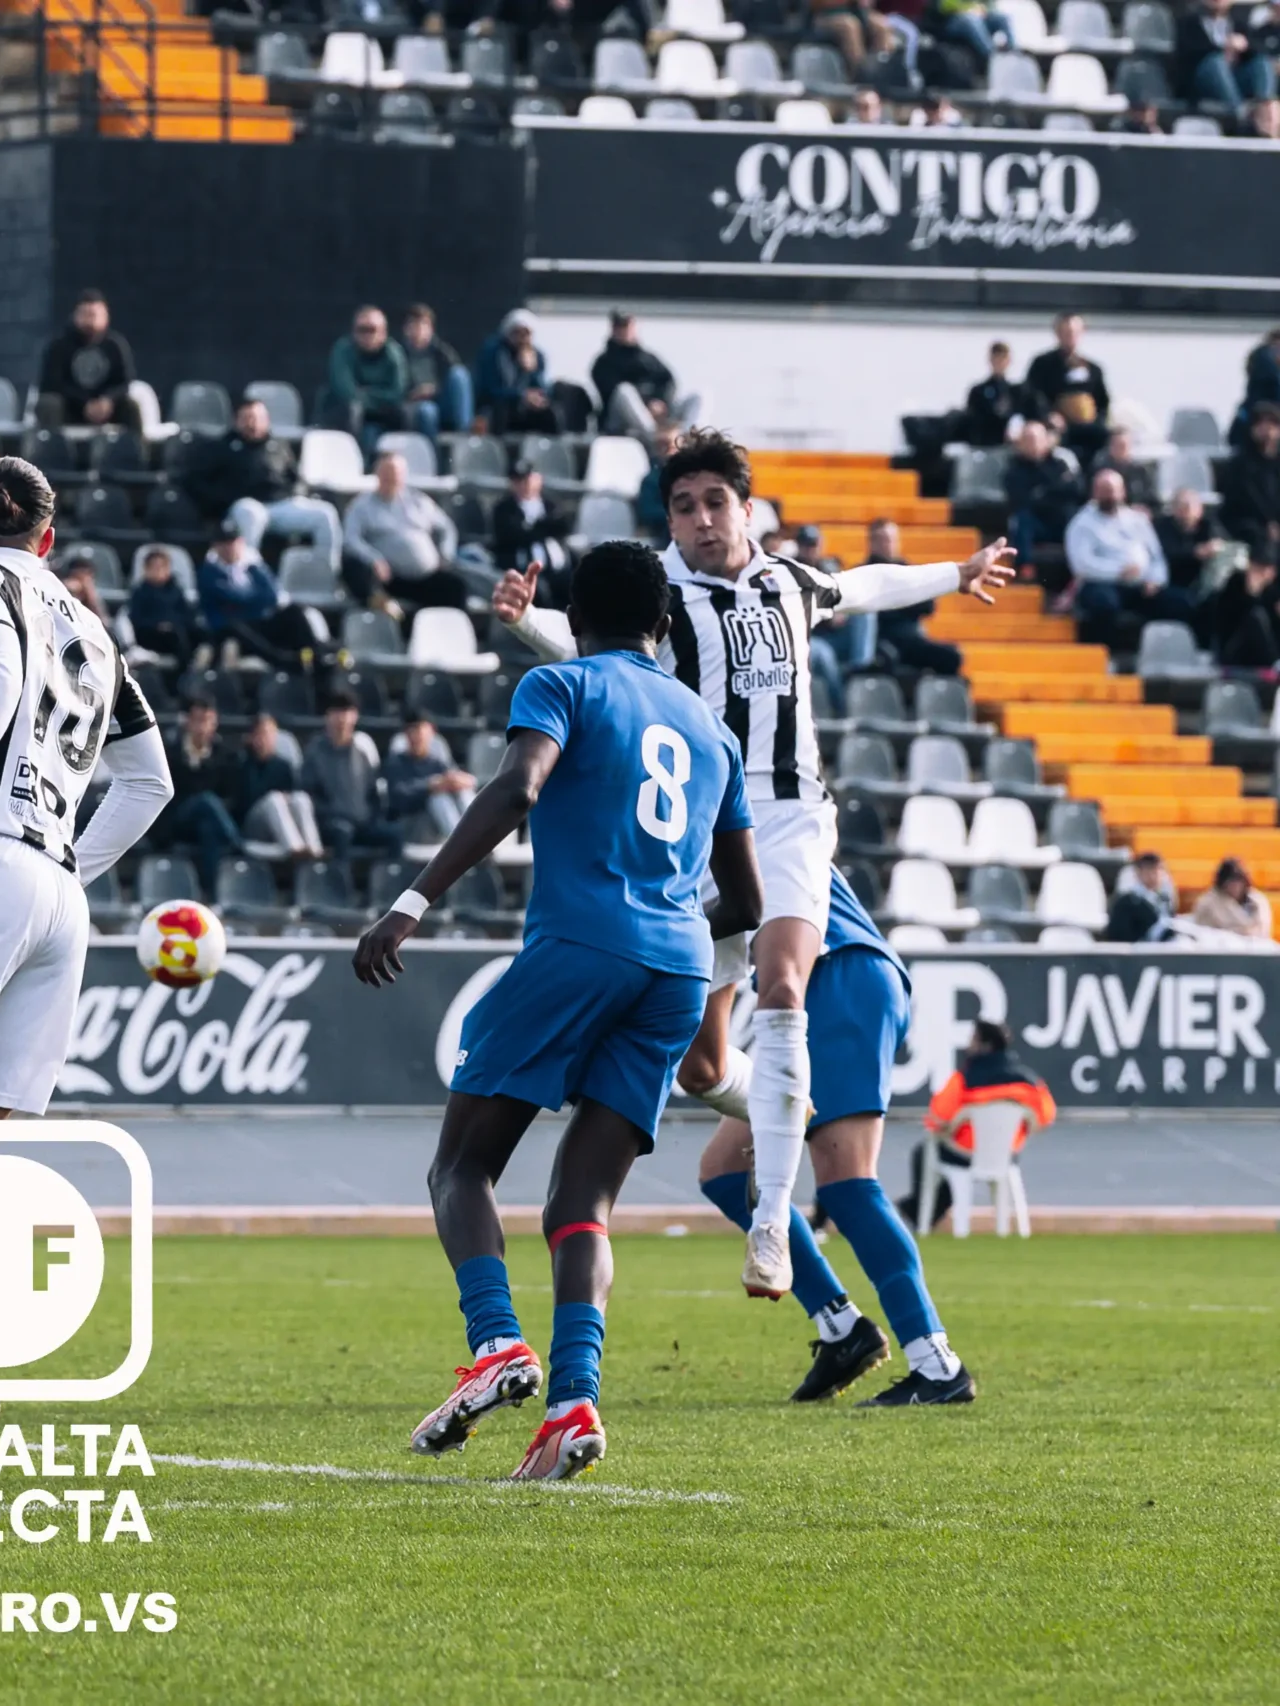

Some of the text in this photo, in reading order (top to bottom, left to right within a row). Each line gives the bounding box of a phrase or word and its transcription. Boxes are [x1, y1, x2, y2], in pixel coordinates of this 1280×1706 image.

[735, 142, 1101, 226] CONTIGO
[636, 724, 691, 843] 8
[58, 951, 324, 1096] a-Cola
[1022, 965, 1271, 1058] JAVIER
[1070, 1054, 1280, 1095] CARPI
